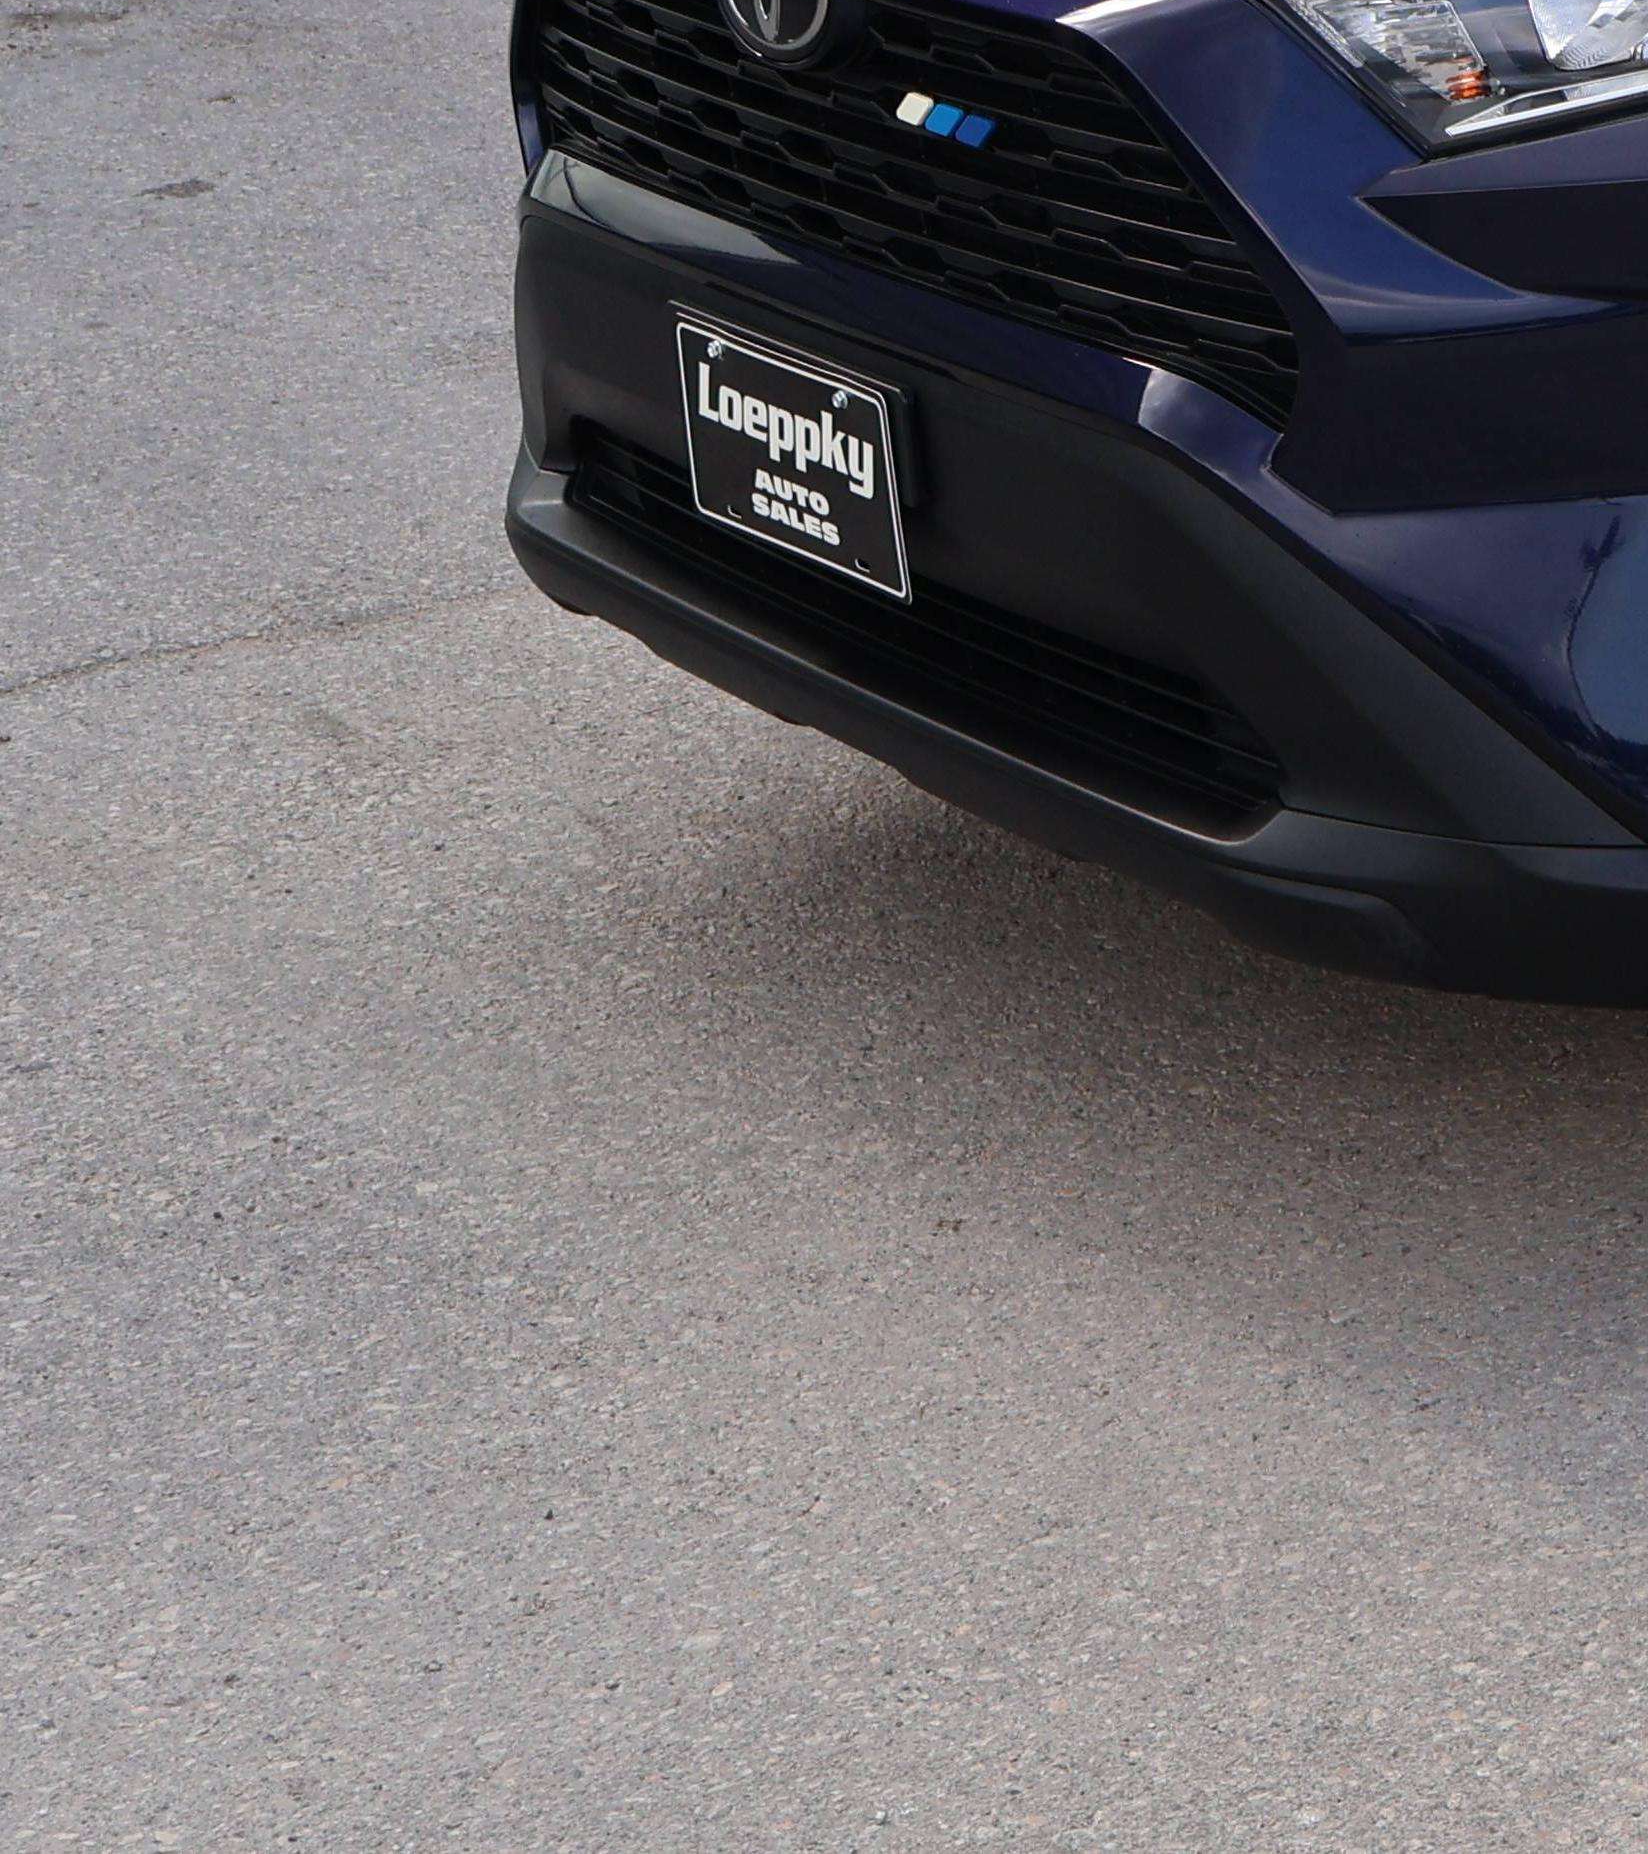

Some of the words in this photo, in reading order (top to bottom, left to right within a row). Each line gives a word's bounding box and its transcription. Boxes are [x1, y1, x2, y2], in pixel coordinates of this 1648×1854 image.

[697, 361, 875, 500] Loeppky
[751, 492, 841, 547] SALES
[755, 468, 831, 516] AUTO
